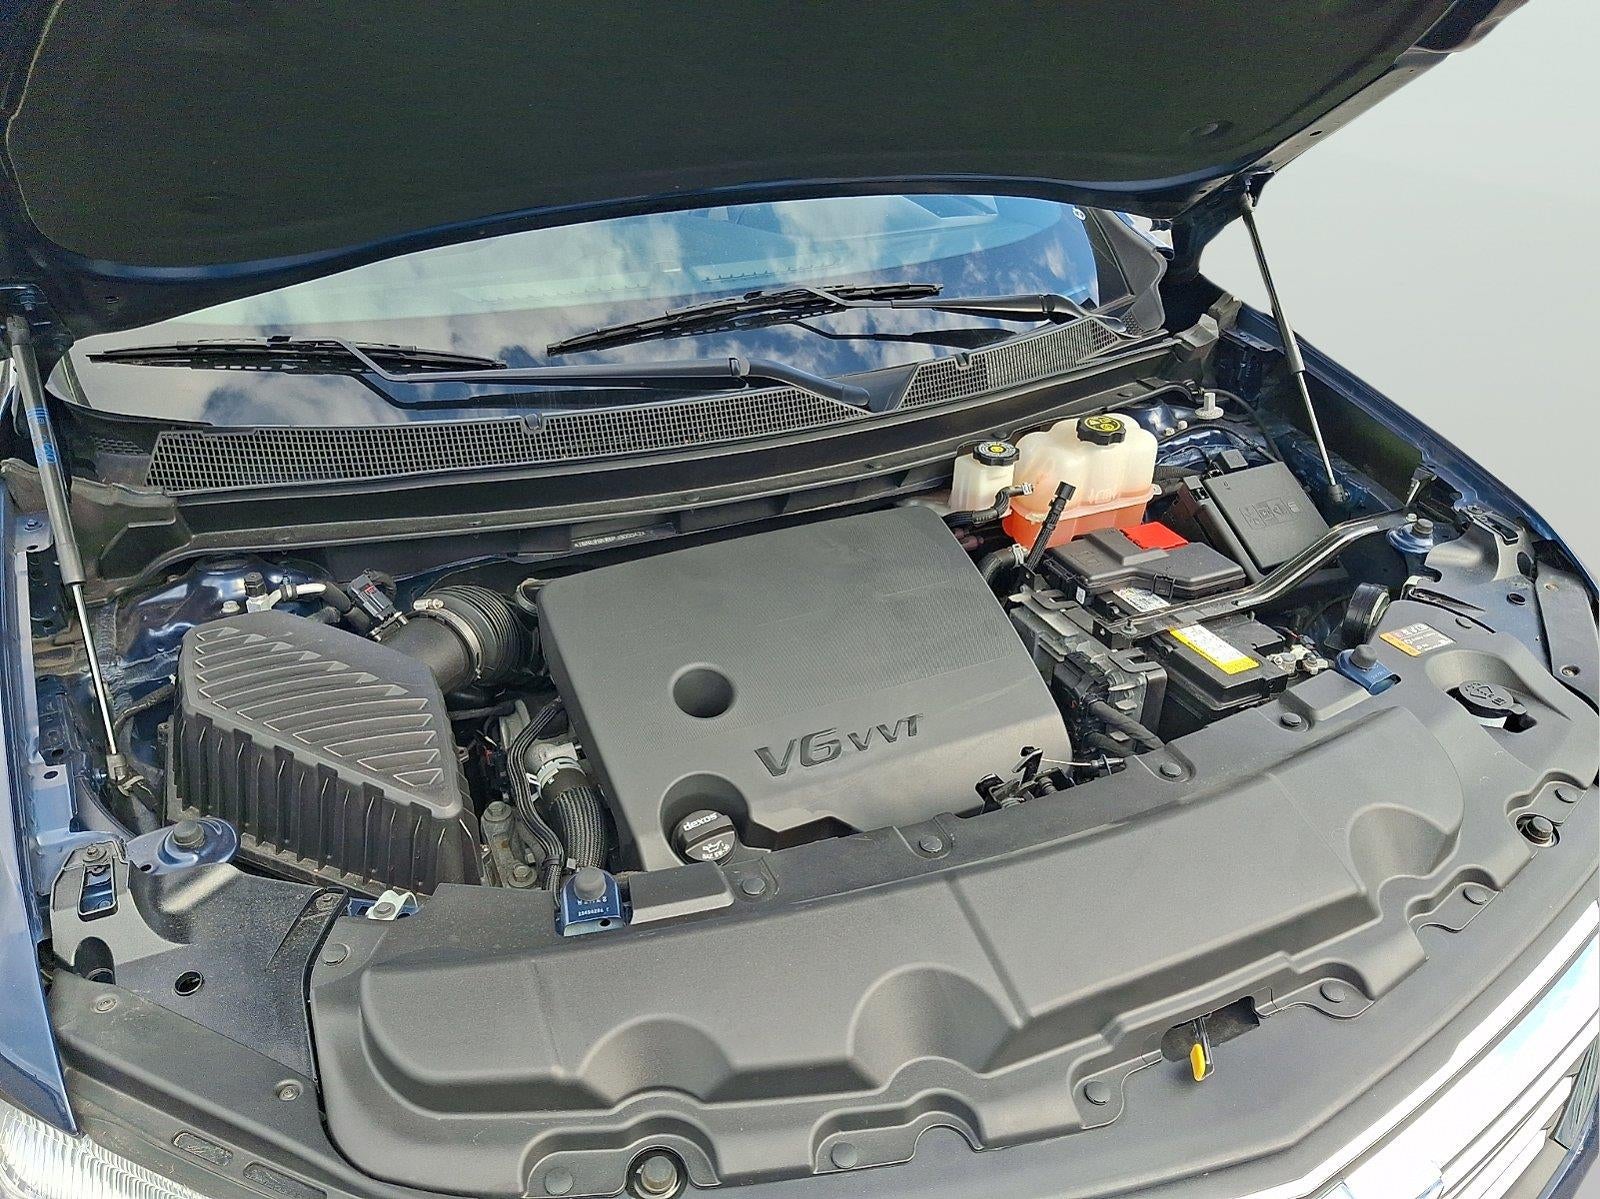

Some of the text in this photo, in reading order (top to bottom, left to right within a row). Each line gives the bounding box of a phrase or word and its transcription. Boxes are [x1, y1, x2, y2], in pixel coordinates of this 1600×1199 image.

[754, 713, 923, 777] V6 VVT
[683, 812, 718, 831] dexos
